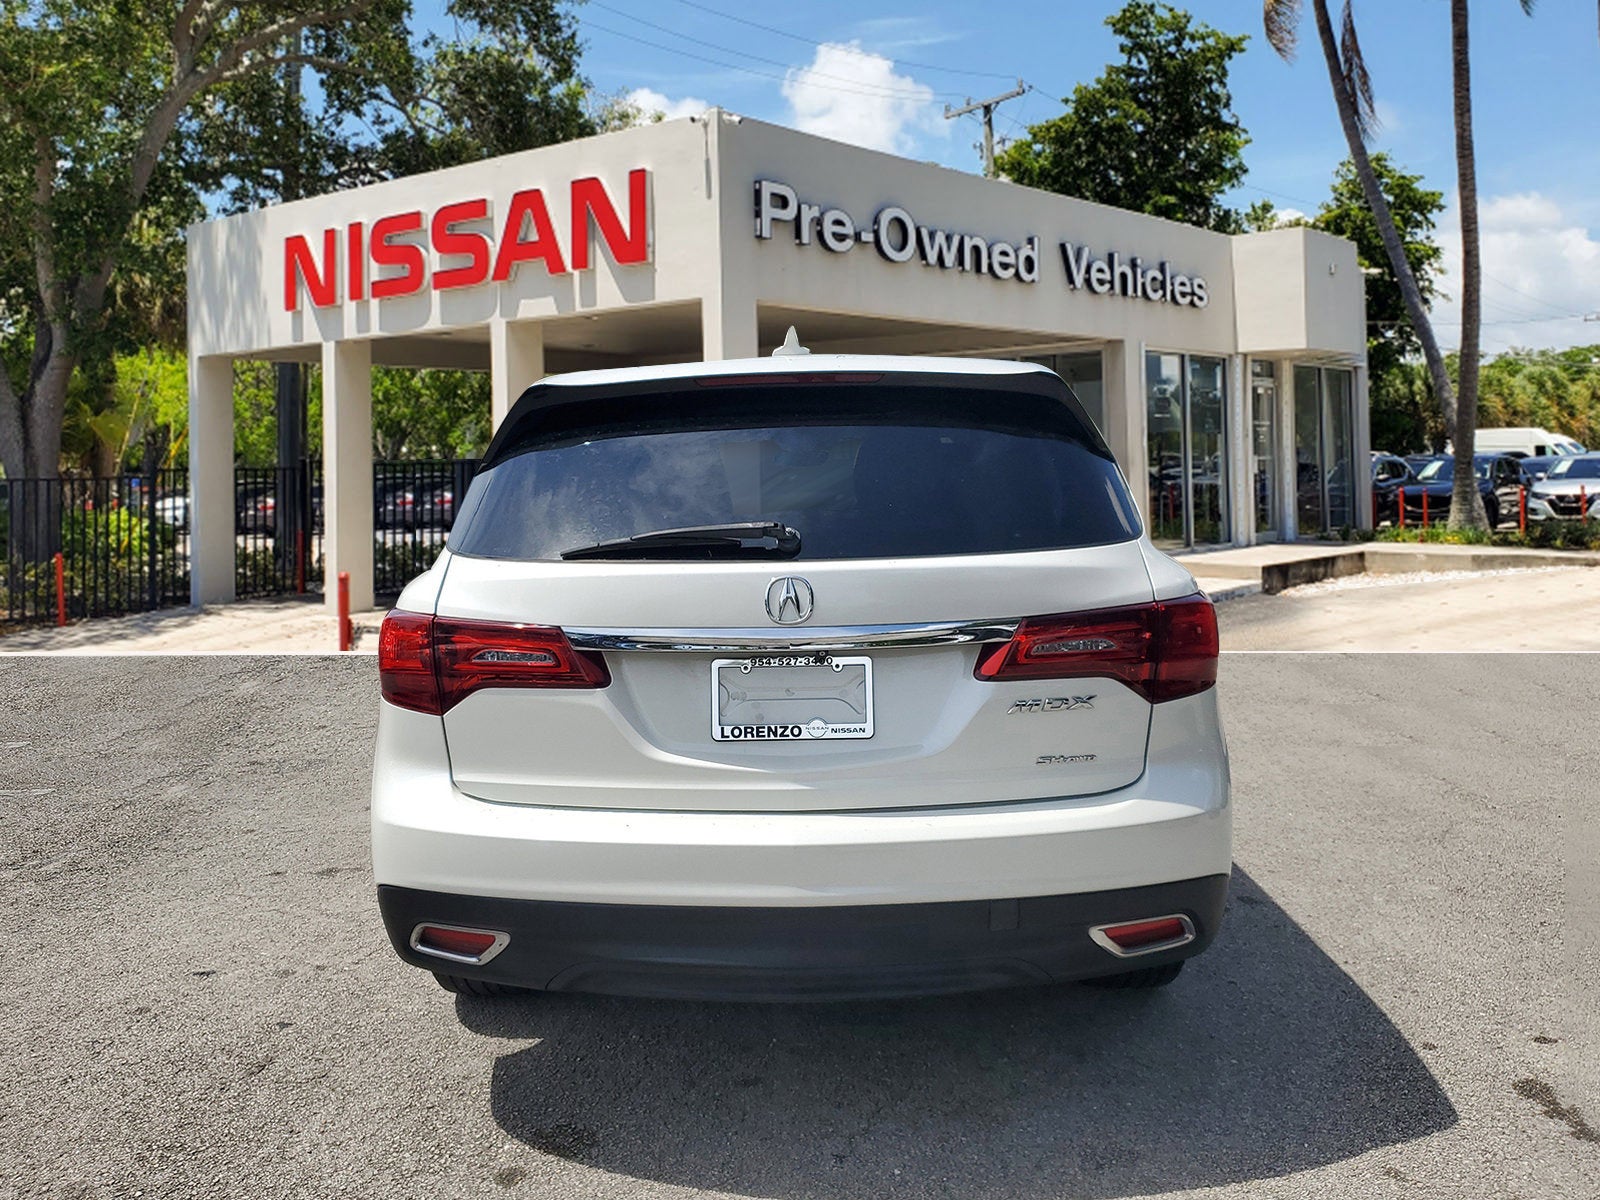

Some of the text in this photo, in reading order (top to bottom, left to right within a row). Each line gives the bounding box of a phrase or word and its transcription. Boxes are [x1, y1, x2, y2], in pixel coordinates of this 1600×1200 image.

[285, 168, 651, 312] NISSAN
[754, 179, 1209, 309] Pre-Owned Vehicles
[721, 725, 803, 739] LORENZO
[830, 726, 866, 735] NISSAN
[1007, 694, 1098, 716] MDX
